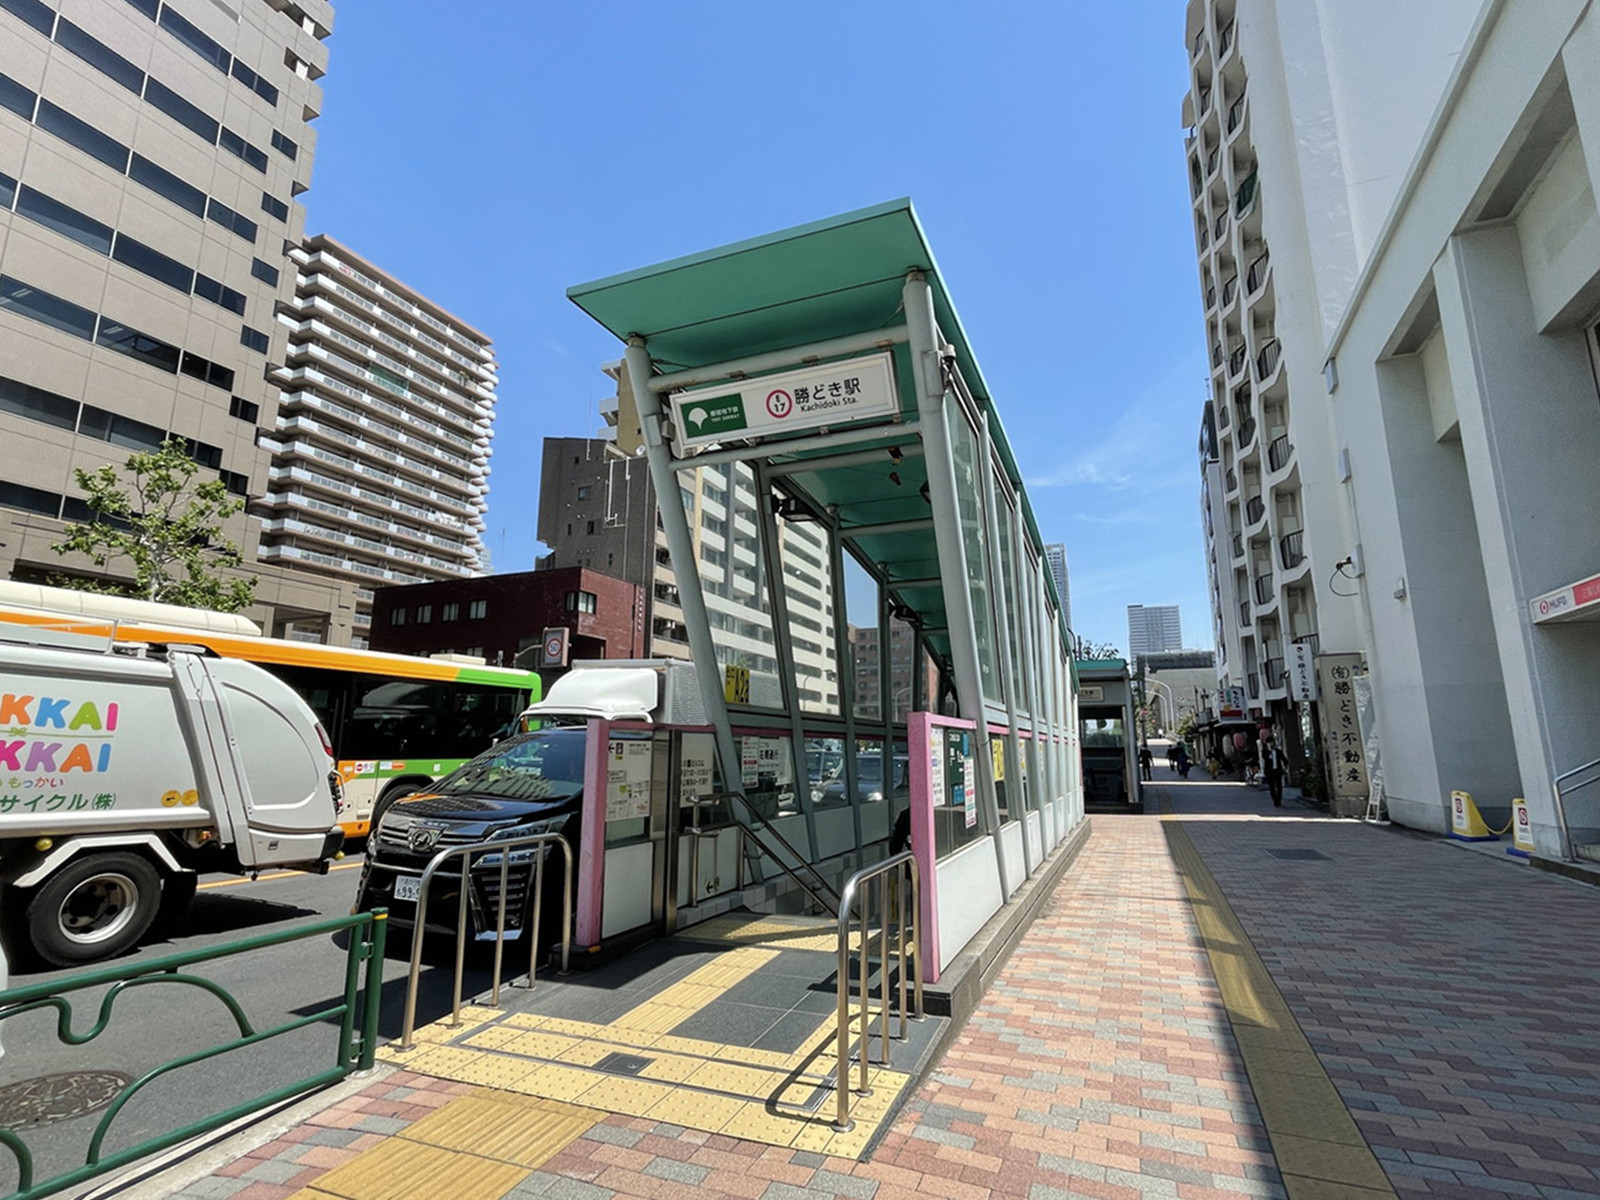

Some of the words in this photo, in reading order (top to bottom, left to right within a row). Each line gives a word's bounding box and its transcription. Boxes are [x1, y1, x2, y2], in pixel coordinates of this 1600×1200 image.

[775, 394, 780, 403] E
[794, 377, 861, 405] 勝どき駅
[774, 402, 786, 413] 17
[801, 398, 841, 412] Kachidoki
[842, 396, 859, 406] Sta.
[0, 693, 119, 731] KKAI
[0, 740, 112, 773] KKAI
[8, 777, 64, 789] もっかい
